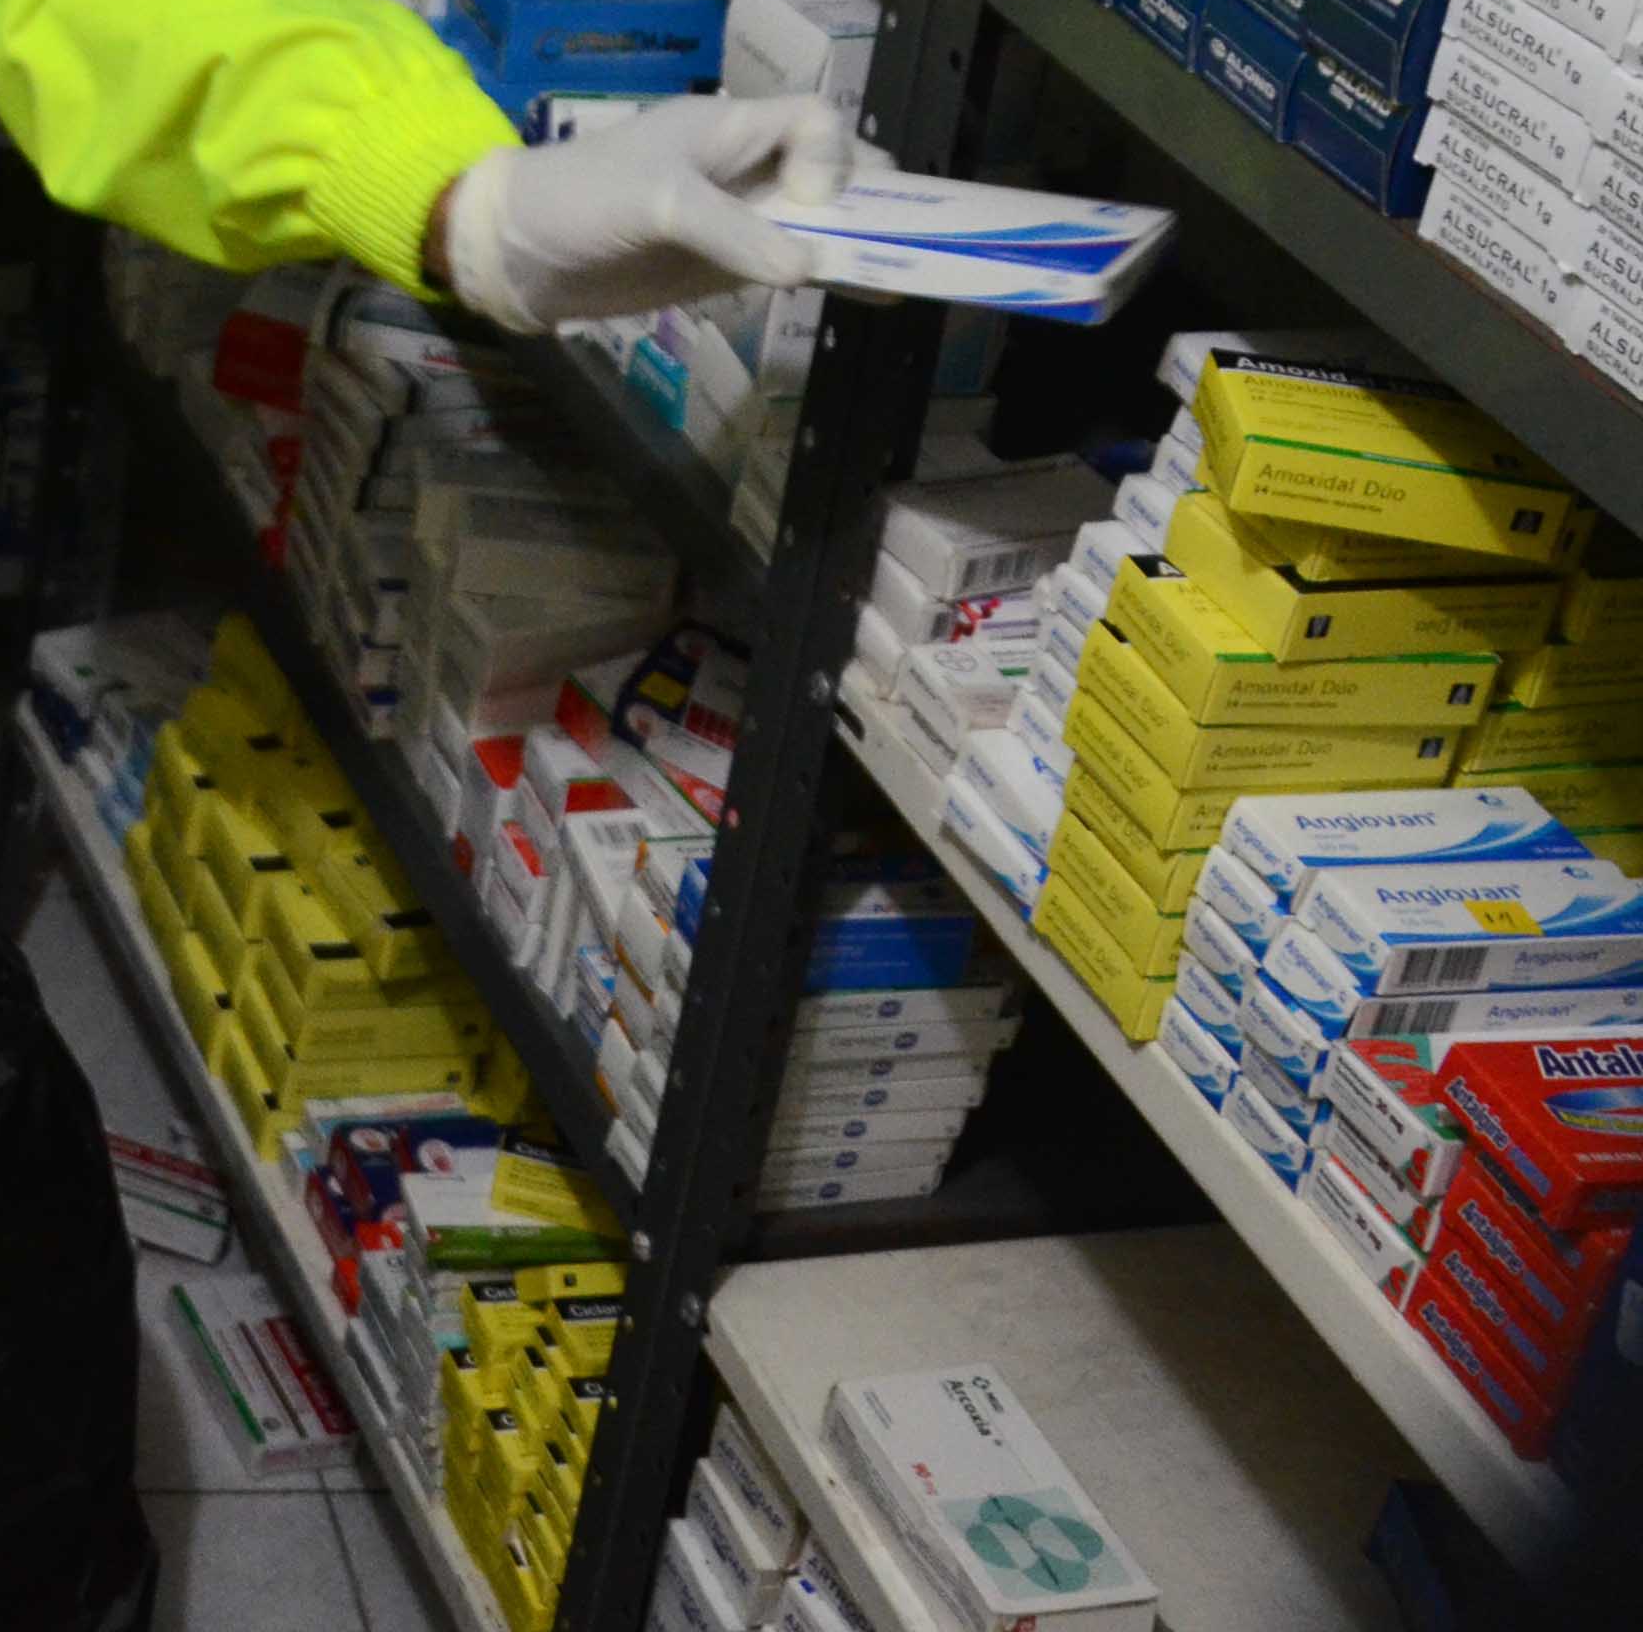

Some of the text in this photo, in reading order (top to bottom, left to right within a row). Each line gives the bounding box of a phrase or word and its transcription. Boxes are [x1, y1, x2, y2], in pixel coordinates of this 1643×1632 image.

[1225, 51, 1277, 101] ALOND
[1564, 60, 1583, 85] 1g
[1448, 70, 1566, 160] ALSUCRAL 1g
[1439, 134, 1553, 226] ALSUCRAL 1g
[1442, 209, 1558, 305] ALSUCRAL 1g
[1258, 462, 1407, 504] Amoxidal Dúo
[1295, 811, 1431, 834] Angiovan
[1374, 883, 1521, 907] Angiovan
[1514, 948, 1605, 967] Angiovan
[1486, 1003, 1577, 1021] Angiovan
[1445, 1076, 1511, 1152] Antalgine
[1458, 1199, 1525, 1275] Antalgine
[1443, 1249, 1508, 1326] Antalgine
[1420, 1300, 1482, 1377] Antalgine
[946, 1378, 993, 1437] Arcoxia
